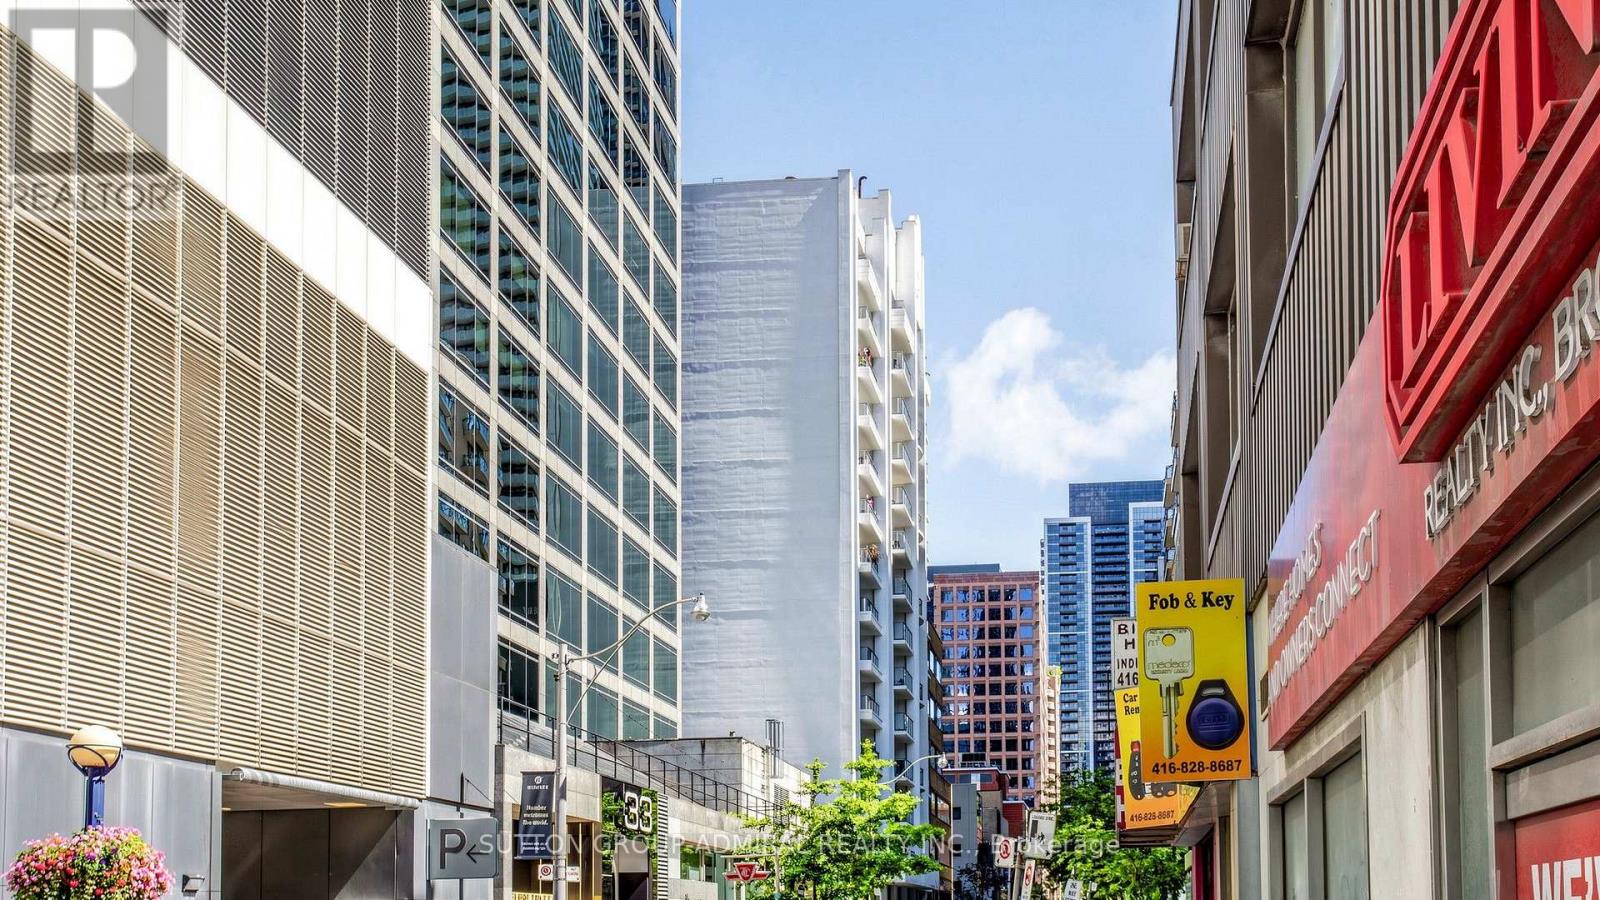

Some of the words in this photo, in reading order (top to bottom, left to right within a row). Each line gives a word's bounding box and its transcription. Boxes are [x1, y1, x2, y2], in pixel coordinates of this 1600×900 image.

[1424, 402, 1491, 540] REALTY
[1552, 250, 1600, 384] BR
[1315, 508, 1382, 638] CONNECT
[1148, 593, 1180, 611] Fob
[1184, 592, 1197, 609] &
[1201, 591, 1235, 610] Key
[1117, 672, 1139, 686] 416
[1123, 693, 1138, 703] Car
[1152, 760, 1243, 775] 416-828-8687
[624, 791, 653, 833] 33
[440, 829, 466, 870] P
